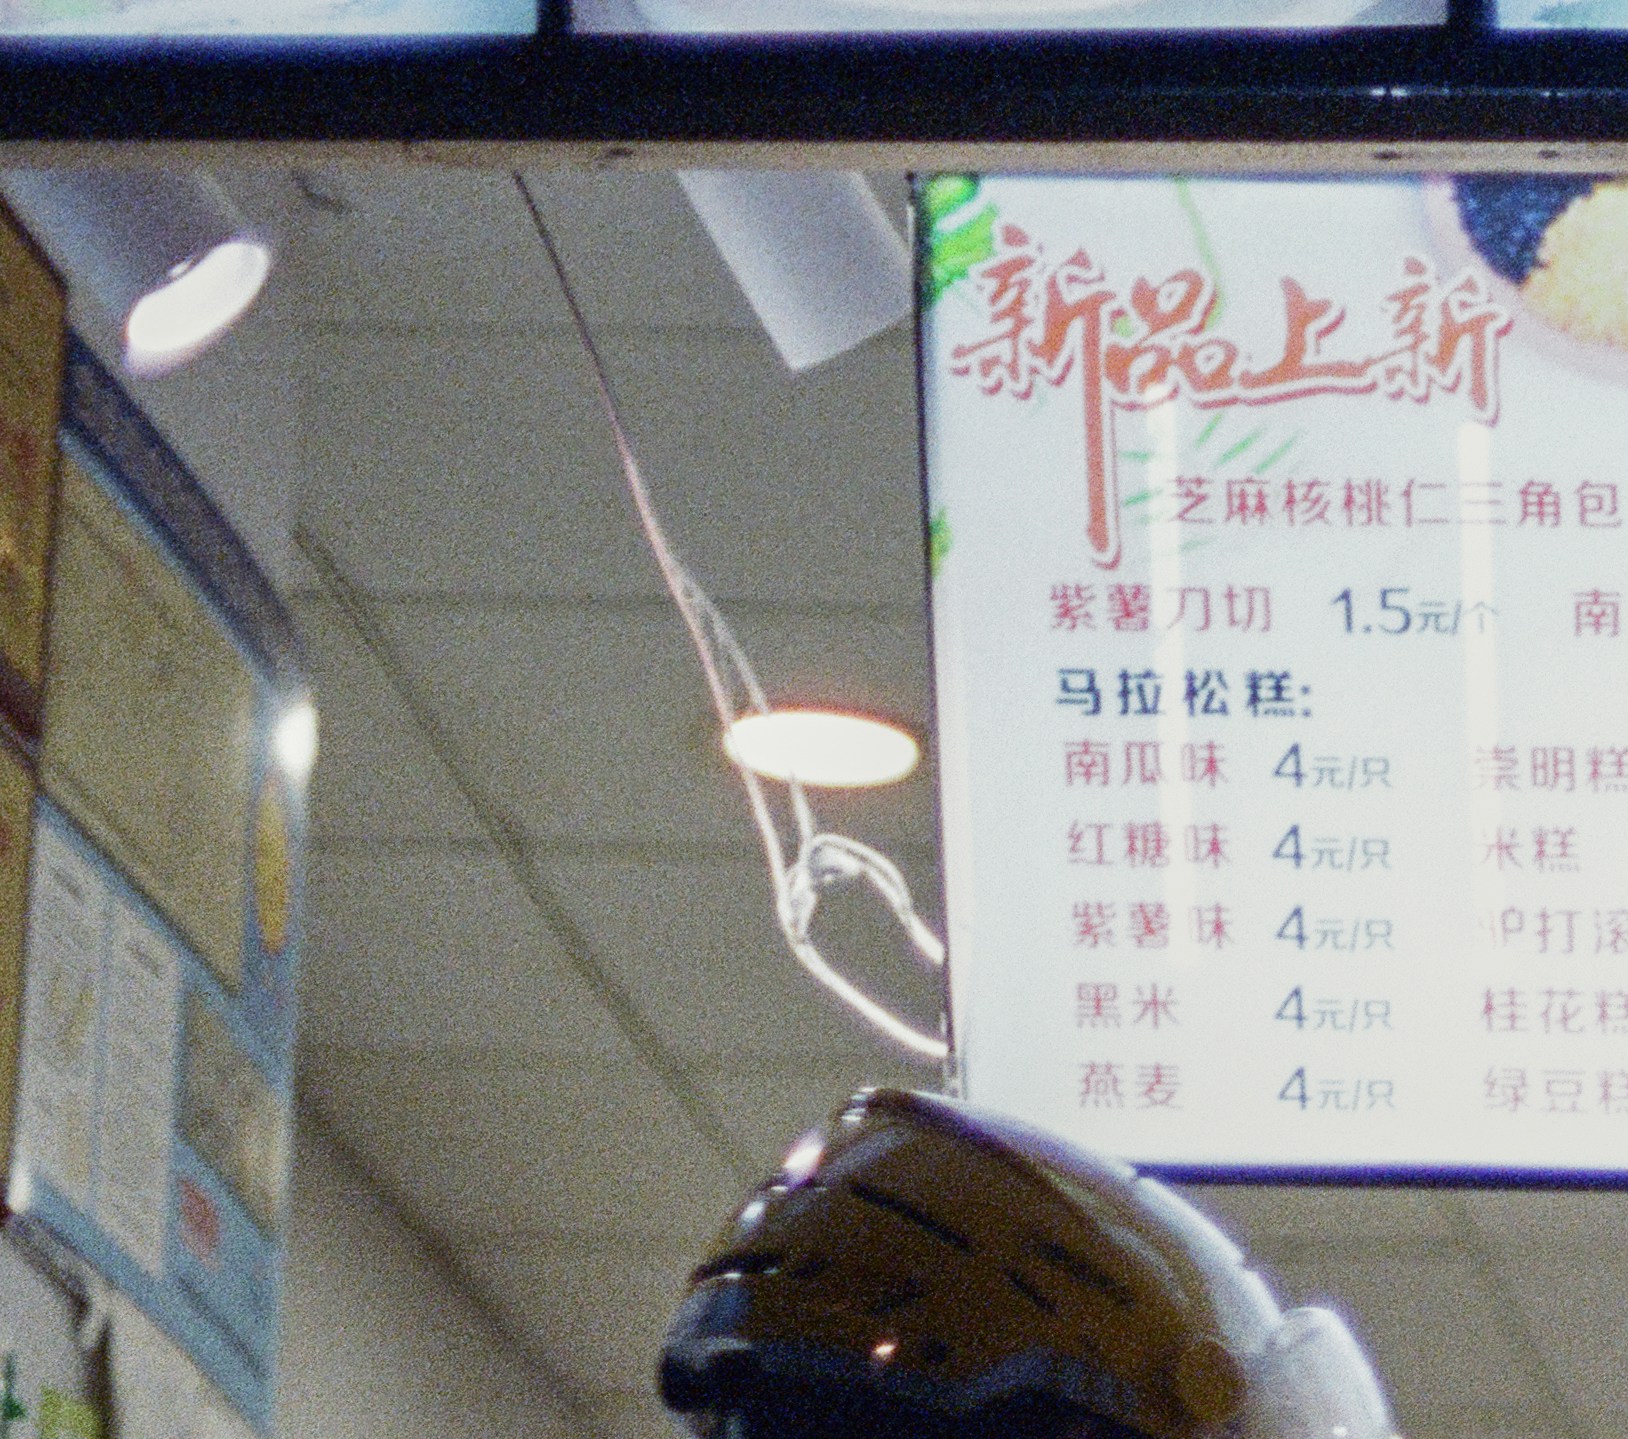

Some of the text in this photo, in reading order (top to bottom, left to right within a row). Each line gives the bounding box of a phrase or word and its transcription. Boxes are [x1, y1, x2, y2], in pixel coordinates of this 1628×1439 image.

[952, 224, 1514, 569] 新品上新
[1173, 473, 1621, 527] 芝麻核桃仁三角包
[1050, 581, 1498, 638] 紫薯刀切 1.5元/个
[1065, 739, 1389, 788] 南瓜味 4元/只
[1067, 820, 1389, 869] 红糖味 4元/只
[1482, 826, 1581, 872] 米糕
[1275, 904, 1392, 950] 4元/只
[1076, 983, 1390, 1030] 黑米 4元/只
[1080, 1061, 1393, 1110] 燕麦 4元/只
